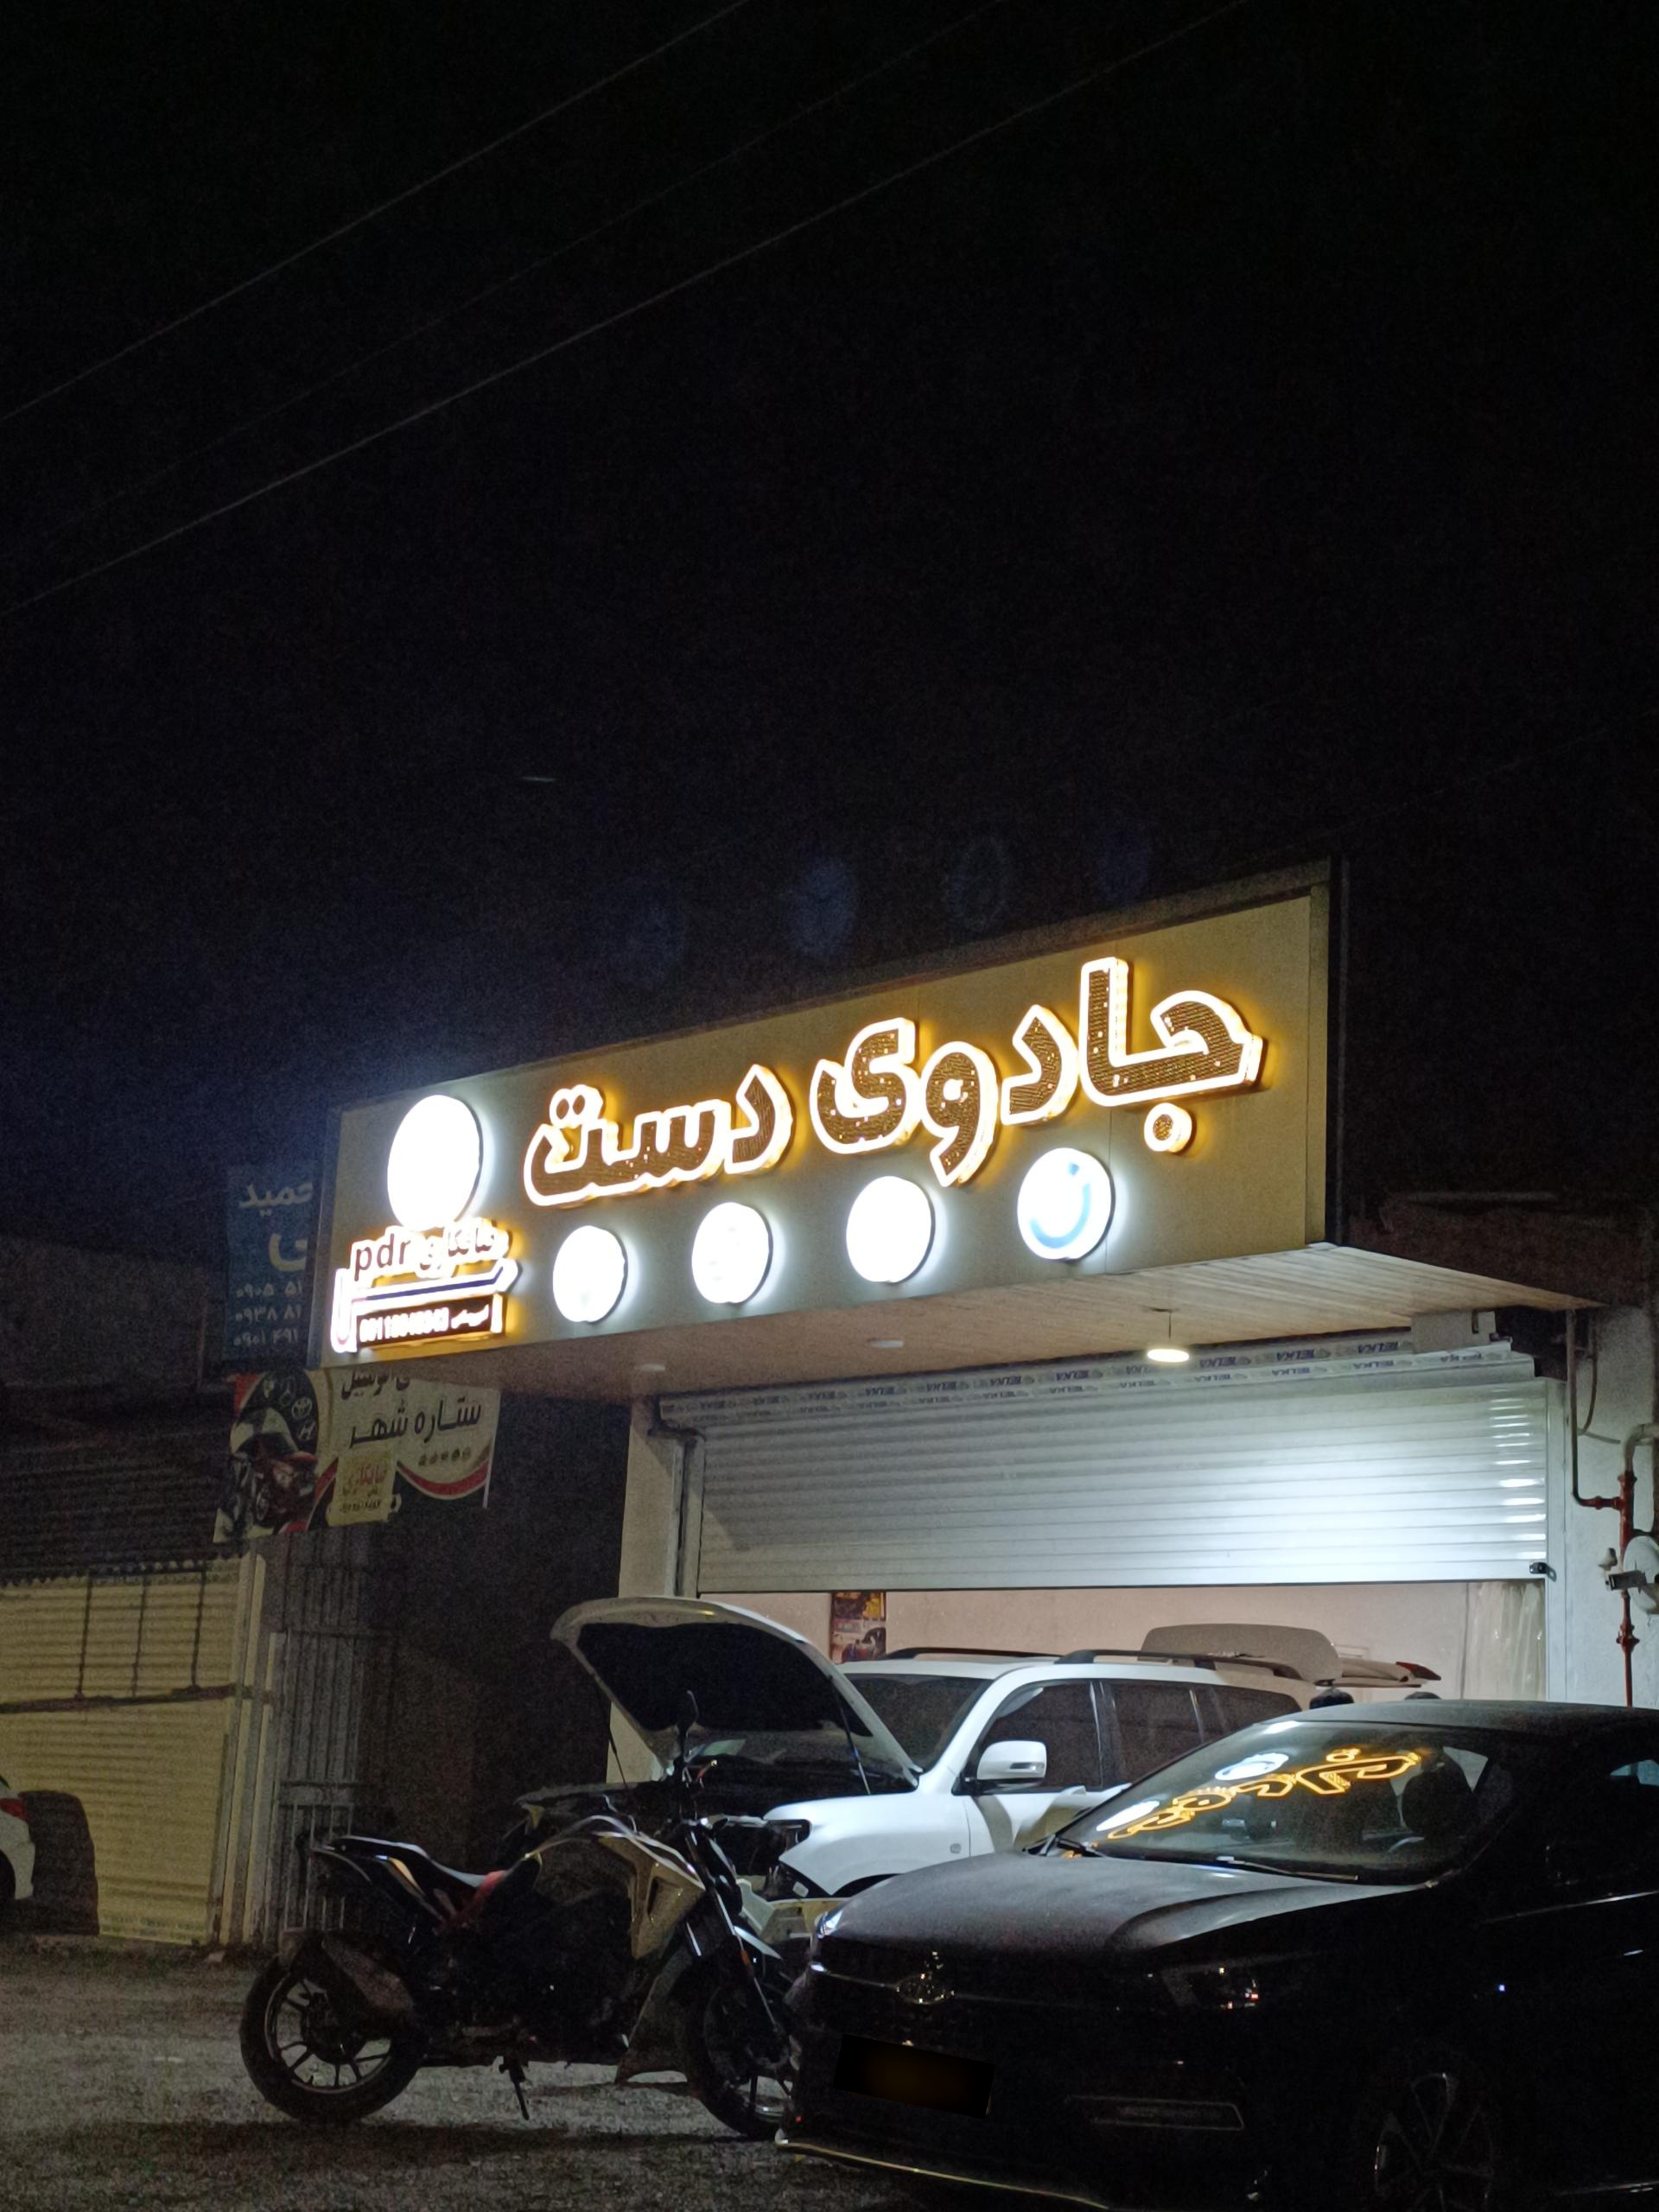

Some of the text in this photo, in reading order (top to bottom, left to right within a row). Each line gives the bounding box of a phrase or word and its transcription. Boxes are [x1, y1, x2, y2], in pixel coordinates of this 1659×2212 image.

[524, 957, 1264, 1206] جادوی دست
[353, 1232, 412, 1281] pdr
[348, 1396, 481, 1449] ستاره شهر
